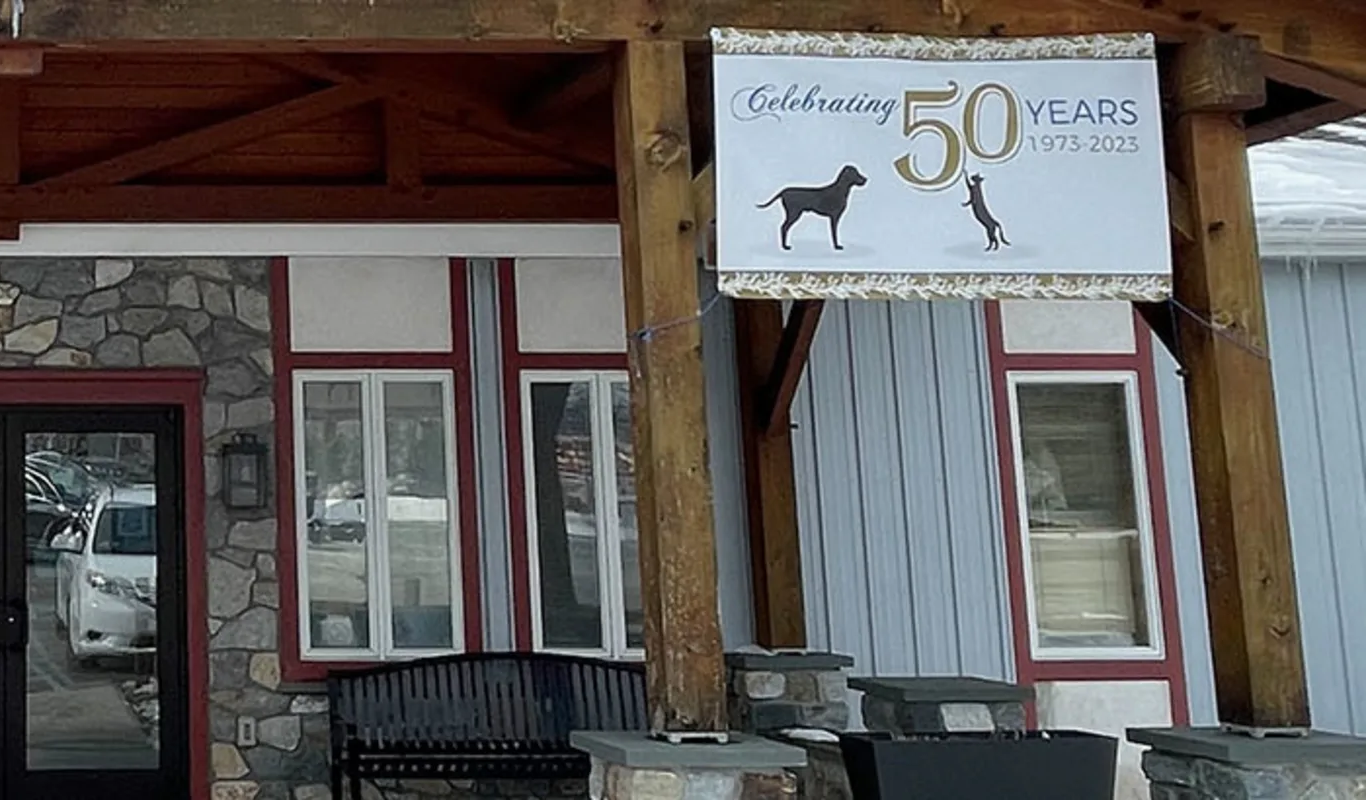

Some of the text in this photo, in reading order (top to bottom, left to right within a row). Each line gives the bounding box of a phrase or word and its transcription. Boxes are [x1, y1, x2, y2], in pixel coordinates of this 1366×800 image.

[732, 80, 1138, 189] Celebrating 50 YEARS
[1028, 135, 1139, 153] 1973-2023
